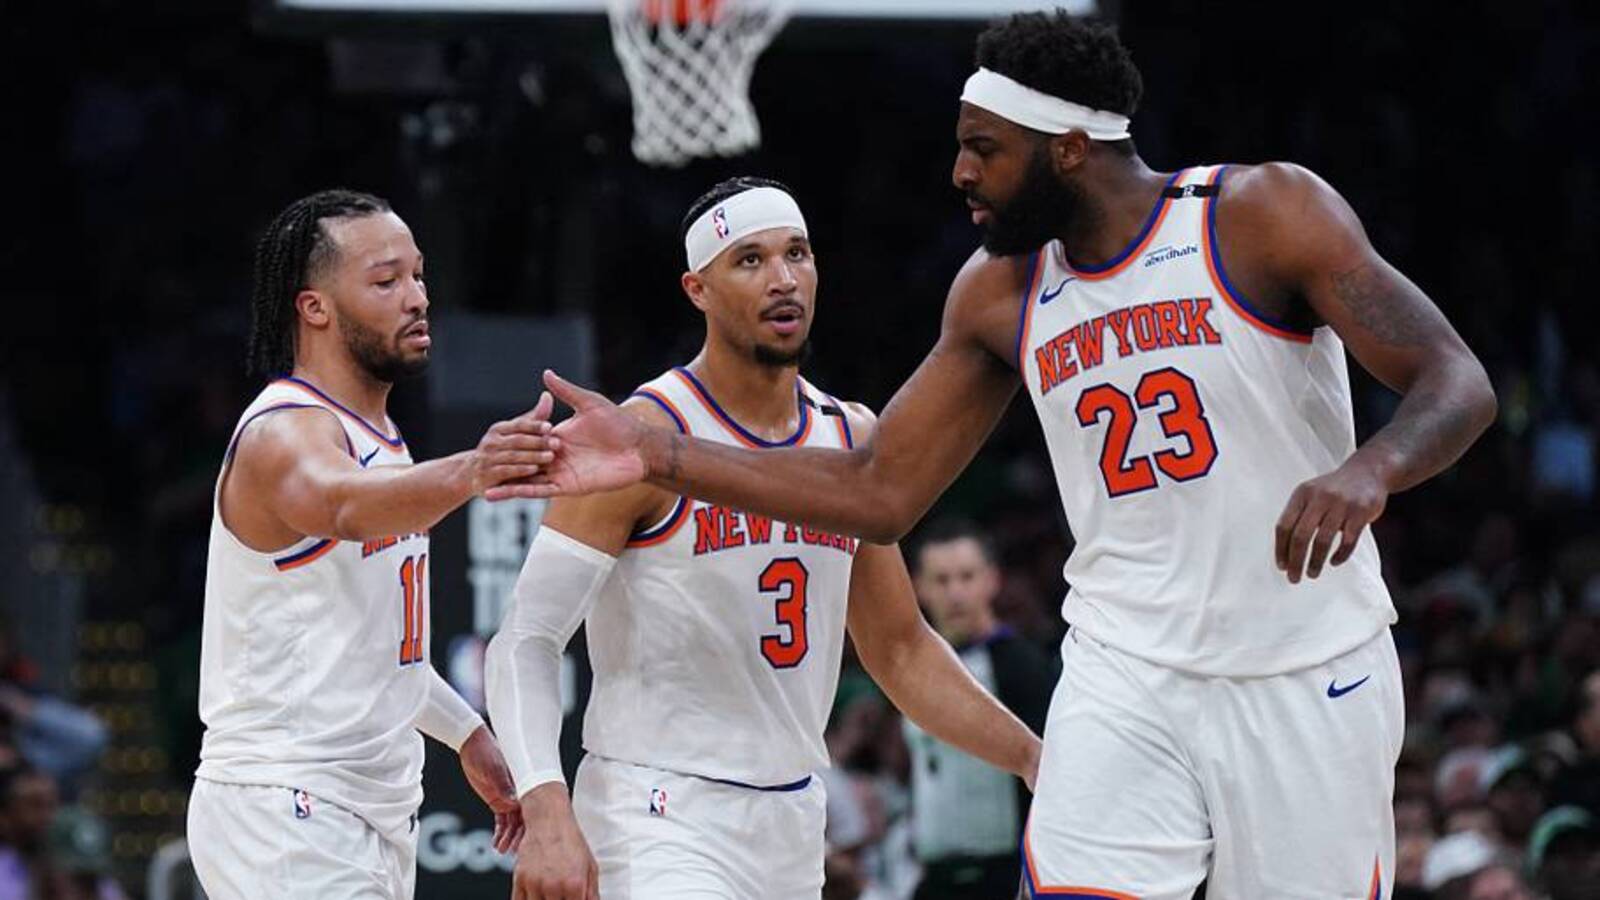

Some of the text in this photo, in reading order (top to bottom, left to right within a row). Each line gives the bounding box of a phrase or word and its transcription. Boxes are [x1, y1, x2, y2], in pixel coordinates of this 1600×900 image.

[1034, 297, 1222, 396] NEW YORK
[1075, 366, 1219, 498] 23
[693, 506, 773, 555] NEW
[399, 553, 427, 666] 11
[758, 556, 809, 669] 3
